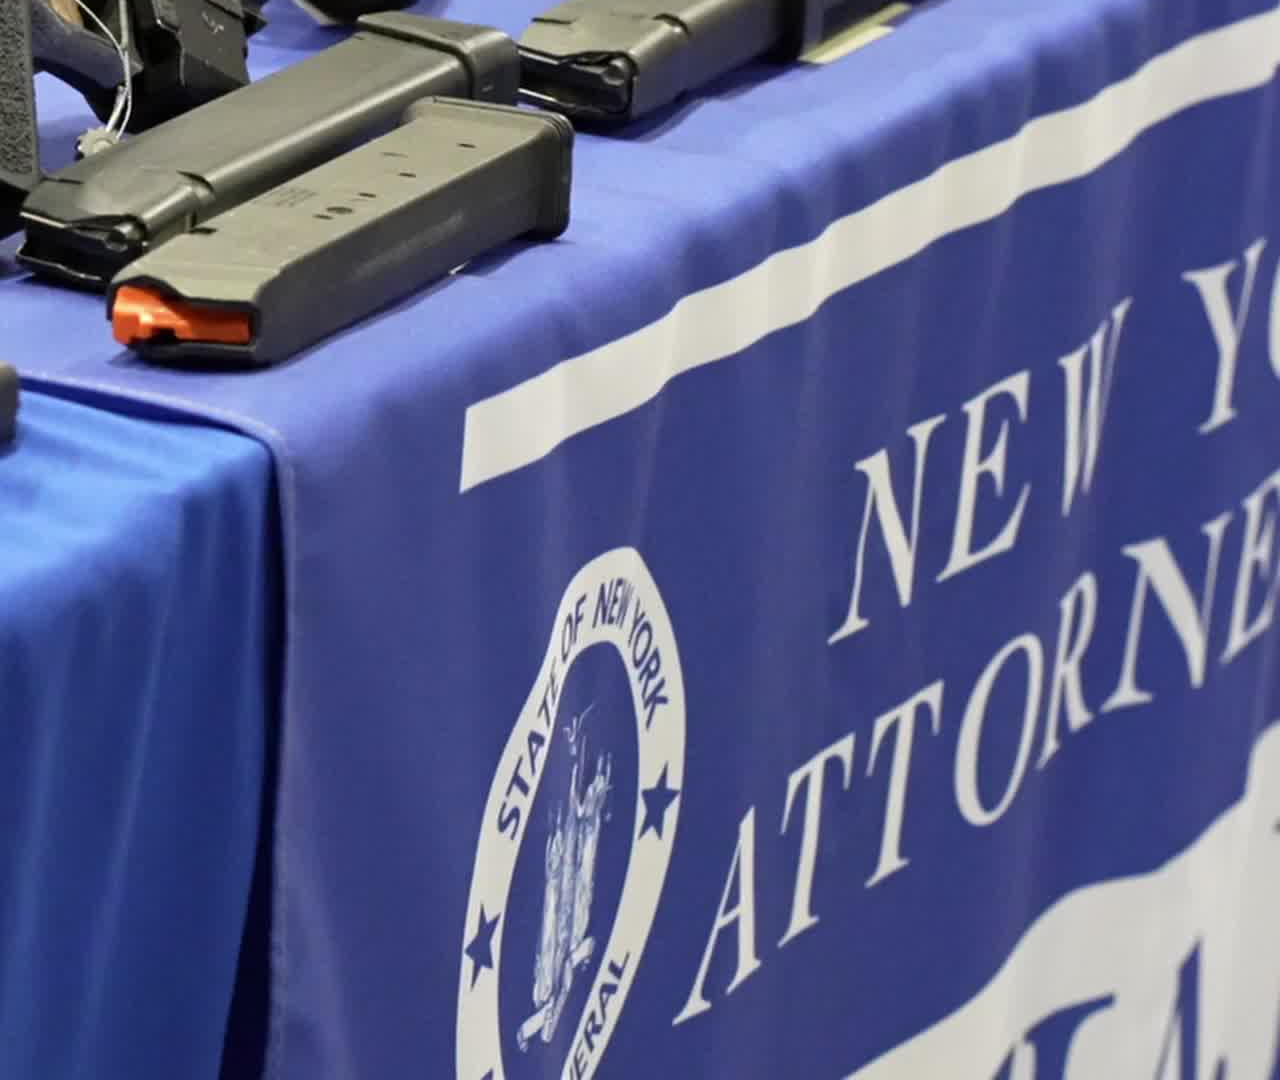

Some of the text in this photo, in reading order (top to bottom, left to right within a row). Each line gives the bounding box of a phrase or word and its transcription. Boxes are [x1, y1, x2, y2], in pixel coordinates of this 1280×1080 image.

[828, 296, 1132, 645] NEW
[497, 576, 668, 839] STATE OF NEW YORK
[569, 951, 630, 1080] ERAL
